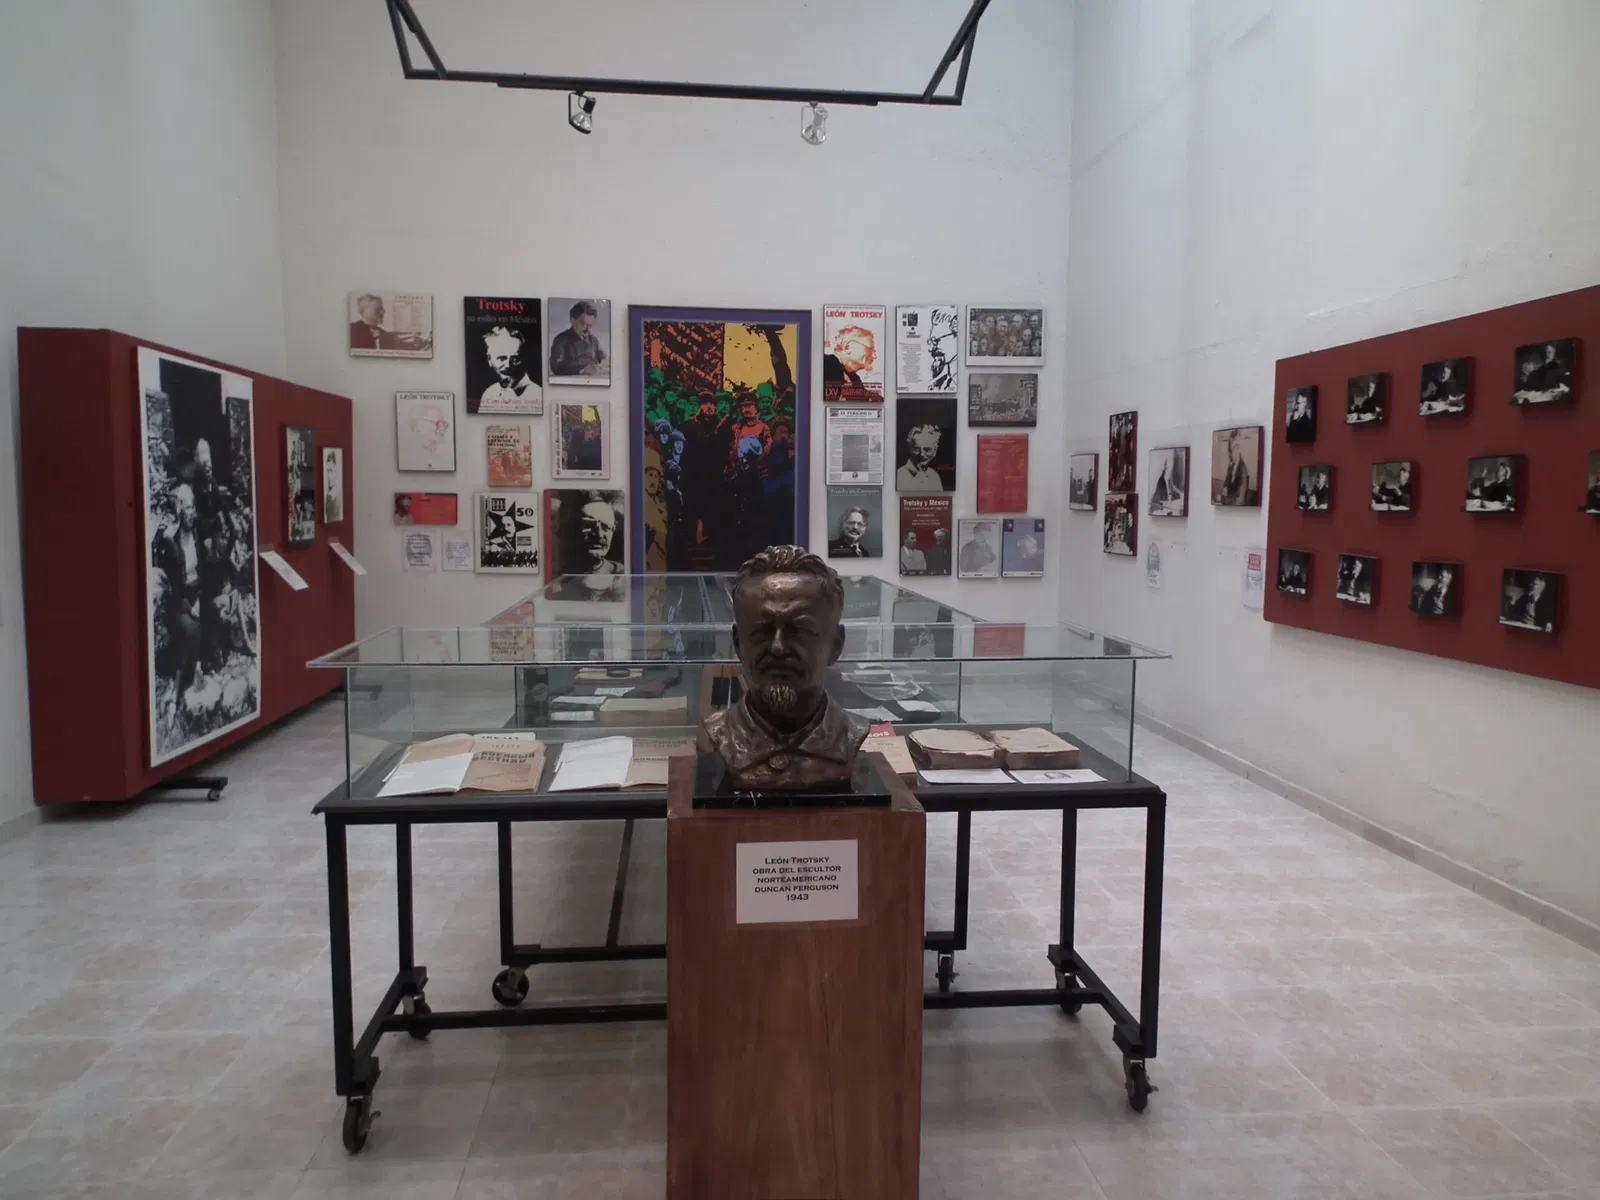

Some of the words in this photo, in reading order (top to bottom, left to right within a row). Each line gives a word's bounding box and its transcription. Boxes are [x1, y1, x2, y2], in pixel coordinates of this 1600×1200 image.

[476, 299, 526, 313] Trotsky
[826, 309, 846, 318] LEÓN
[903, 499, 923, 507] Trotsky
[765, 857, 789, 865] LEÓN
[791, 856, 830, 864] TROTSKY
[797, 865, 842, 873] ESCULTOR
[757, 875, 837, 884] NORTEAMERICANO
[754, 885, 791, 893] DUNCAN
[793, 884, 839, 892] FERGUSON
[786, 893, 809, 901] 1943
